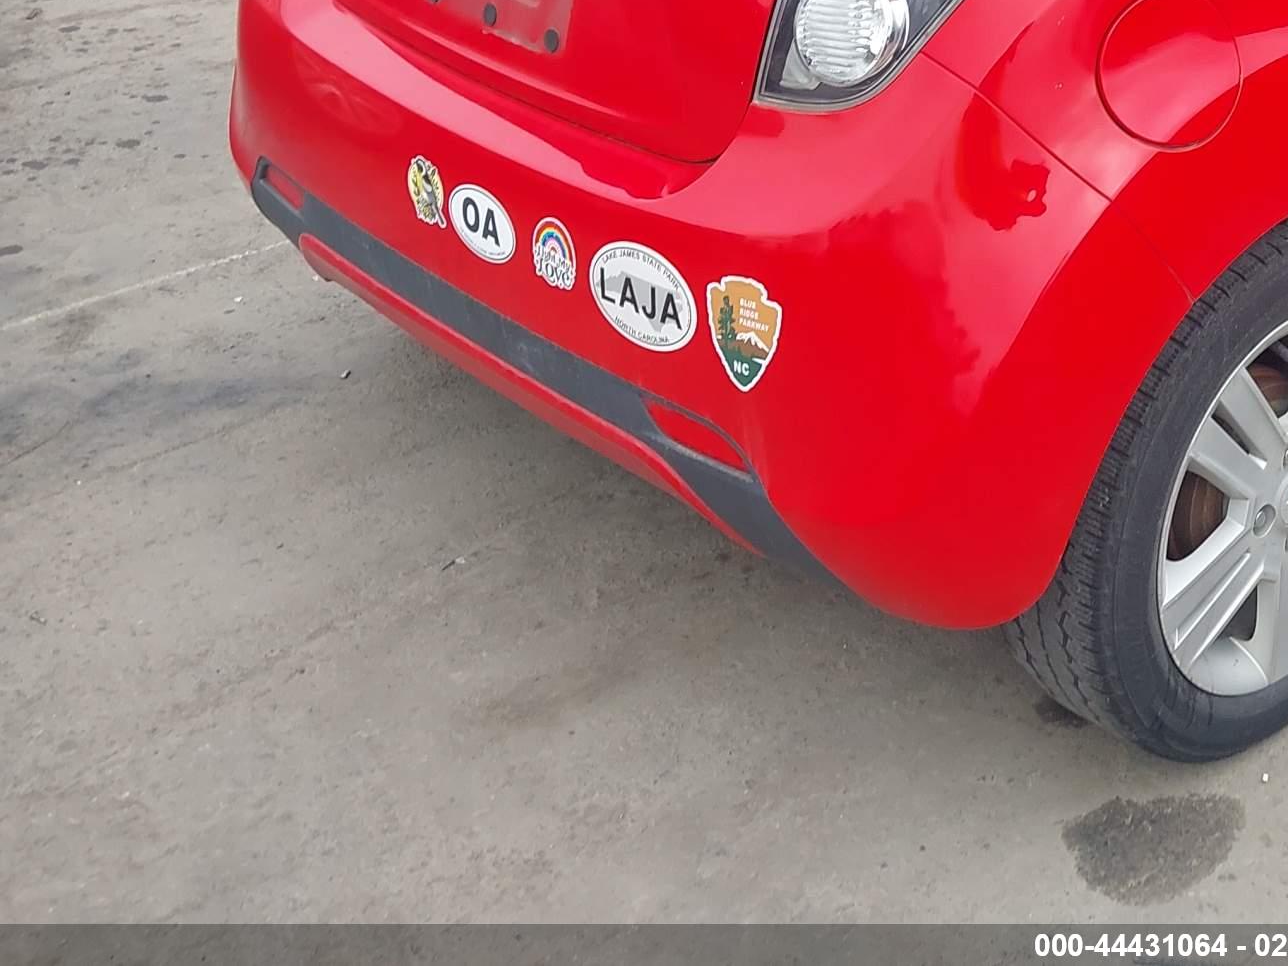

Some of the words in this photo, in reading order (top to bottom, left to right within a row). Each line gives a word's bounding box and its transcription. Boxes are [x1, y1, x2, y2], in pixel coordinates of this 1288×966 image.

[463, 197, 500, 247] OA
[602, 250, 618, 264] LAKE
[619, 250, 640, 260] JAMES
[643, 254, 662, 271] STATE
[663, 270, 680, 290] PARK
[600, 267, 683, 331] LAJA
[739, 298, 756, 309] BLUE
[739, 309, 759, 320] RIDGE
[614, 316, 637, 337] NORTH
[739, 318, 769, 332] PARKWAY
[733, 360, 750, 377] NC
